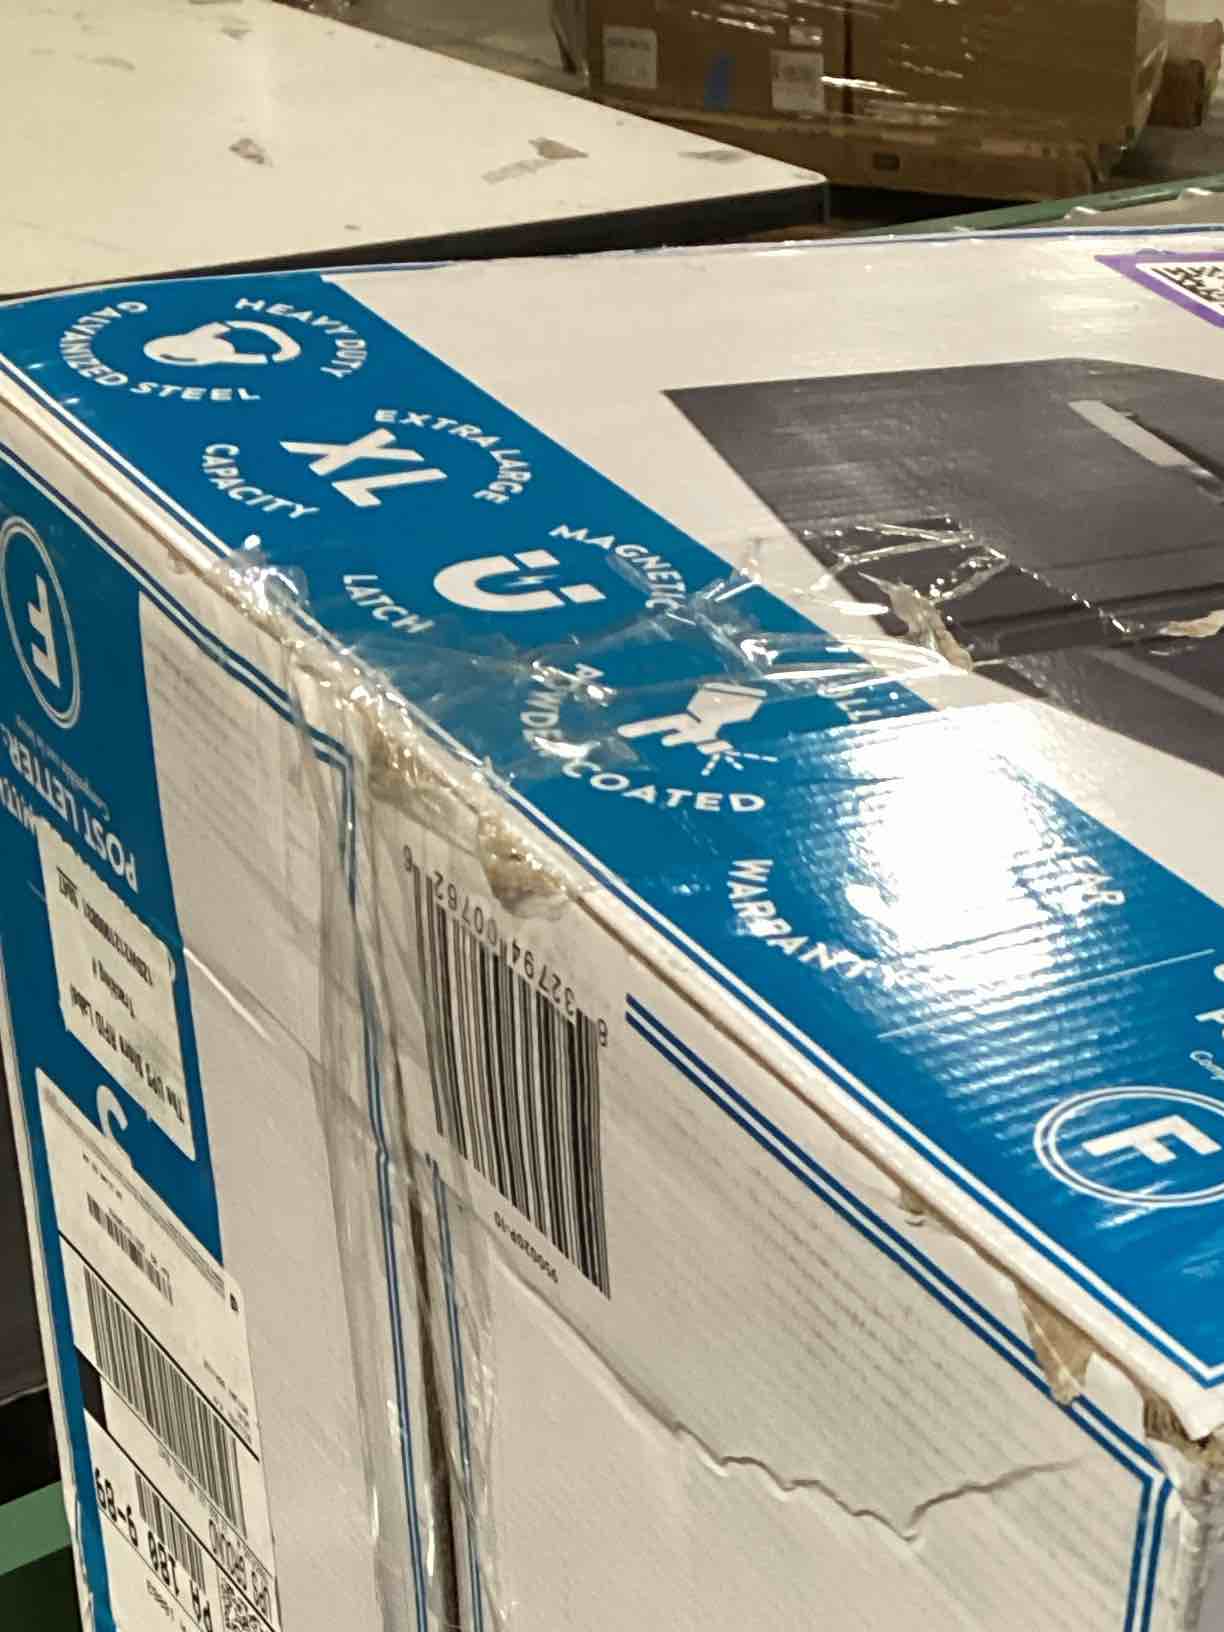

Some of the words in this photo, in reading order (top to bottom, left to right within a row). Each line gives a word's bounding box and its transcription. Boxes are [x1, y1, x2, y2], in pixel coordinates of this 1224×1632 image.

[59, 301, 148, 387] GALVANIZED
[129, 381, 260, 401] STEEL
[235, 297, 350, 343] HEAVY
[320, 338, 368, 378] DUTY
[201, 443, 320, 520] CAPACITY
[280, 428, 447, 507] XL
[374, 408, 484, 445] EXTRA
[473, 441, 532, 504] LARGE
[343, 573, 435, 634] LATCH
[549, 524, 687, 612] MAGNETIC
[27, 575, 60, 689] F
[561, 760, 766, 813] COATED
[83, 808, 138, 895] POST
[432, 869, 499, 948] 00762
[511, 938, 577, 1018] 32794
[1082, 1113, 1223, 1165] F
